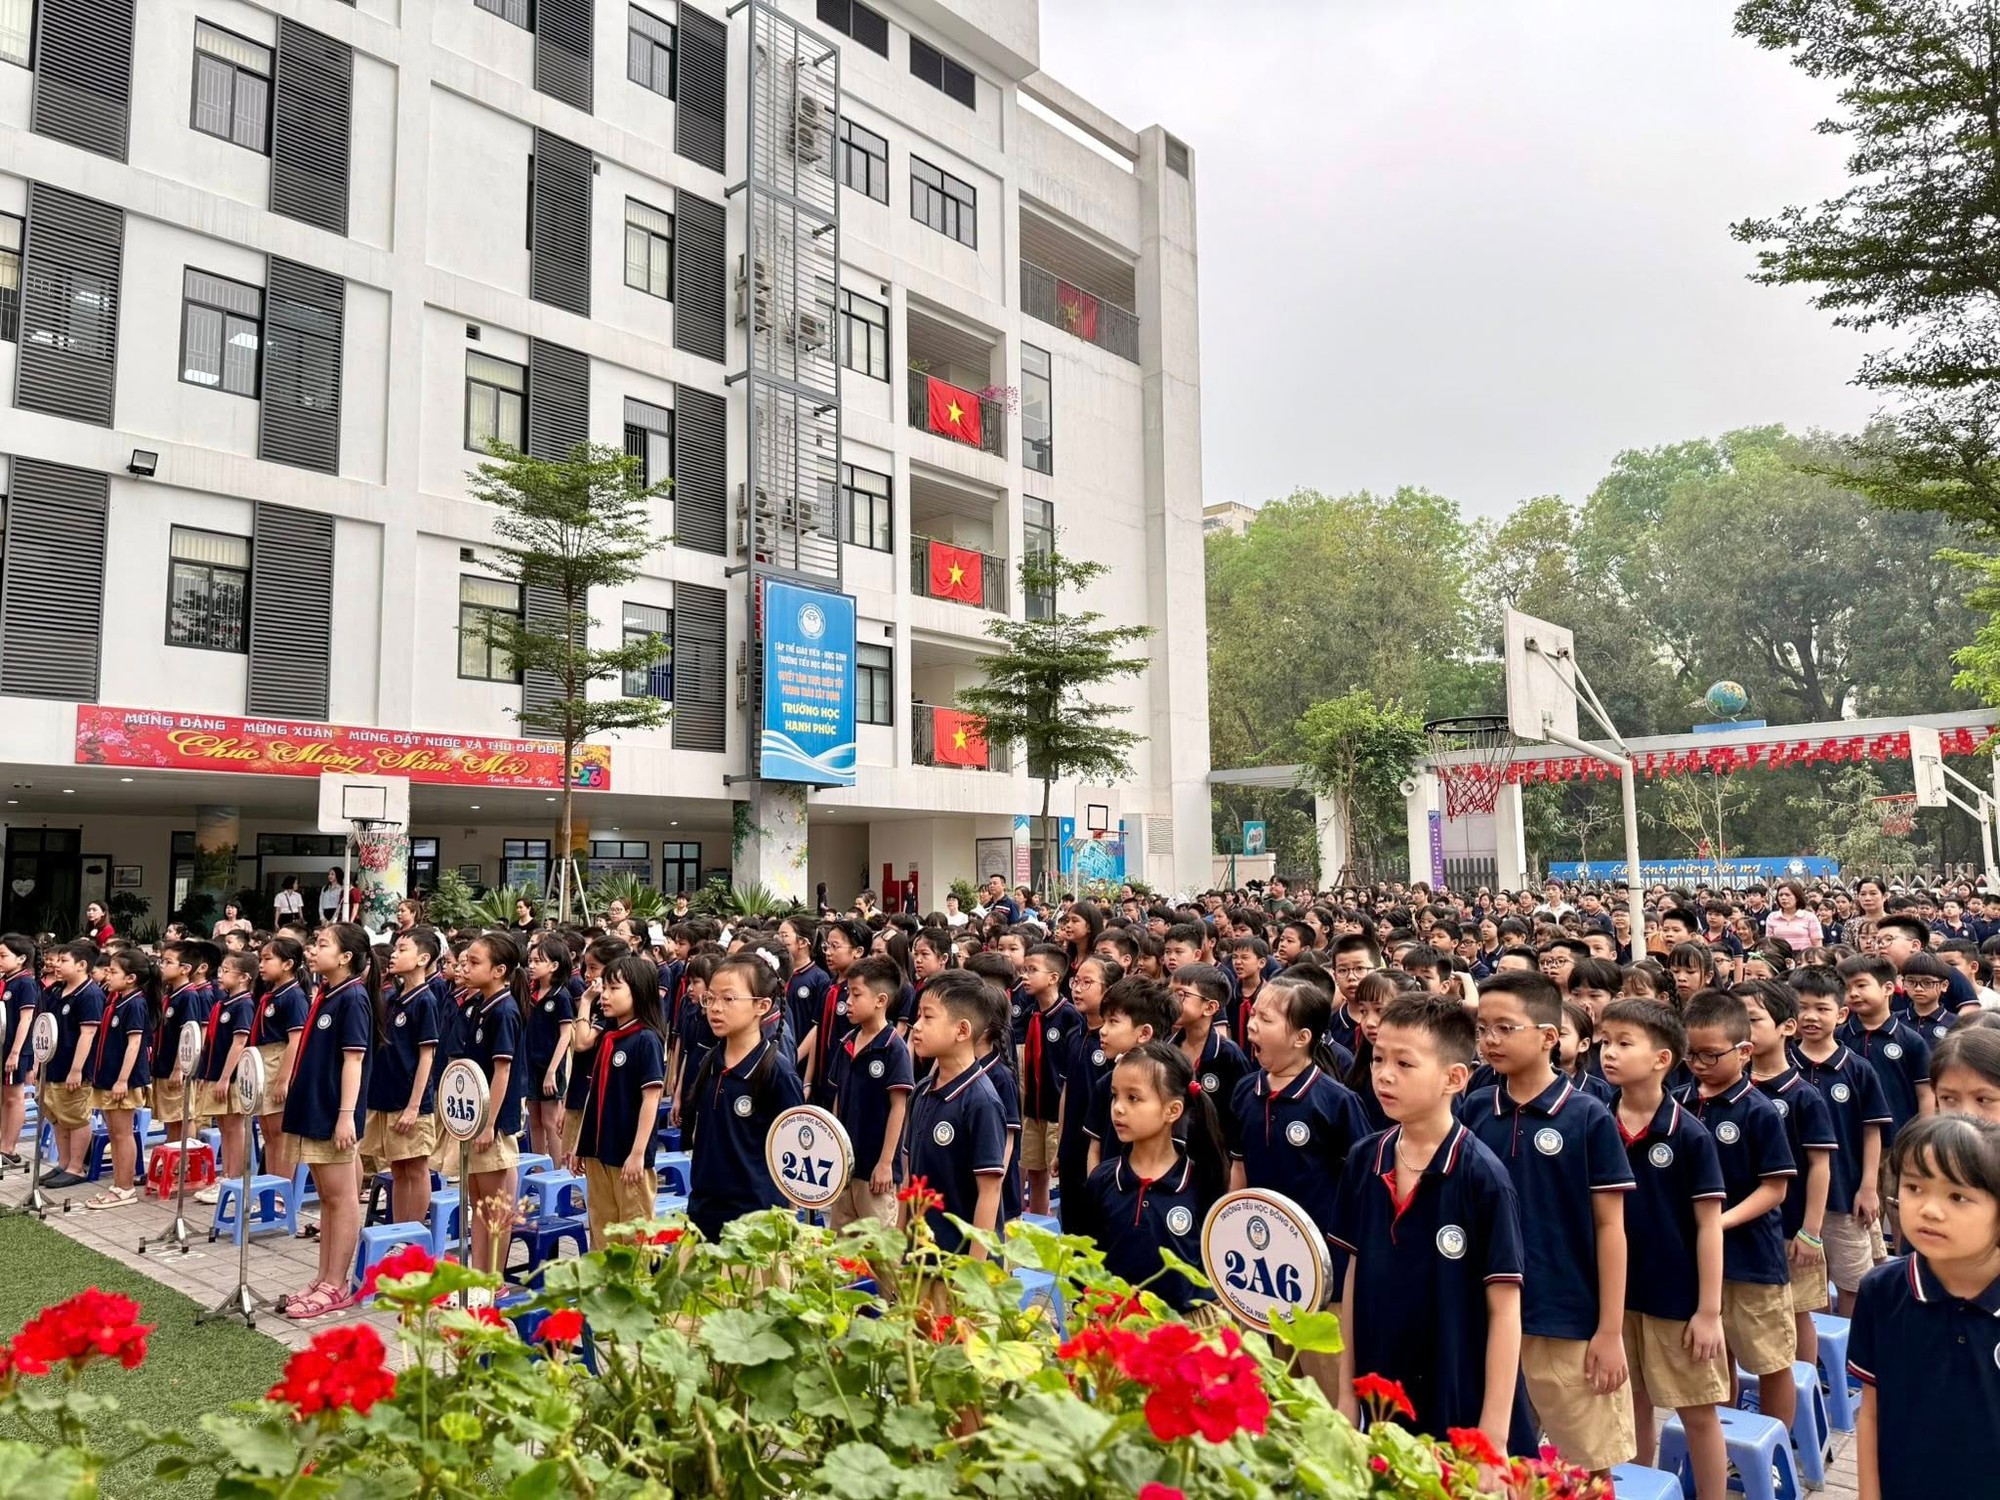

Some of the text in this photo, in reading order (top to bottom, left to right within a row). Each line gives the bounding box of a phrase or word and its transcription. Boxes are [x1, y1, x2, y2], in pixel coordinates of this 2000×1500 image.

[782, 702, 840, 720] TRƯỜNG HỌC
[785, 719, 837, 735] HẠNH PHÚC
[124, 711, 174, 727] MỪNG
[180, 715, 226, 731] ĐẢNG
[243, 718, 287, 735] MỪNG
[293, 723, 333, 738] XUÂN
[349, 727, 389, 743] MỪNG
[426, 734, 461, 748] NƯỚC
[466, 737, 483, 750] VÀ
[167, 729, 529, 775] Chúc Mừng Năm Mới
[447, 1095, 475, 1121] 3A5
[782, 1151, 834, 1188] 2A7
[1220, 1199, 1298, 1239] TRƯỜNG TIỂU HỌC ĐỐNG ĐA
[1224, 1250, 1302, 1303] 2A6
[1229, 1292, 1246, 1310] DONG
